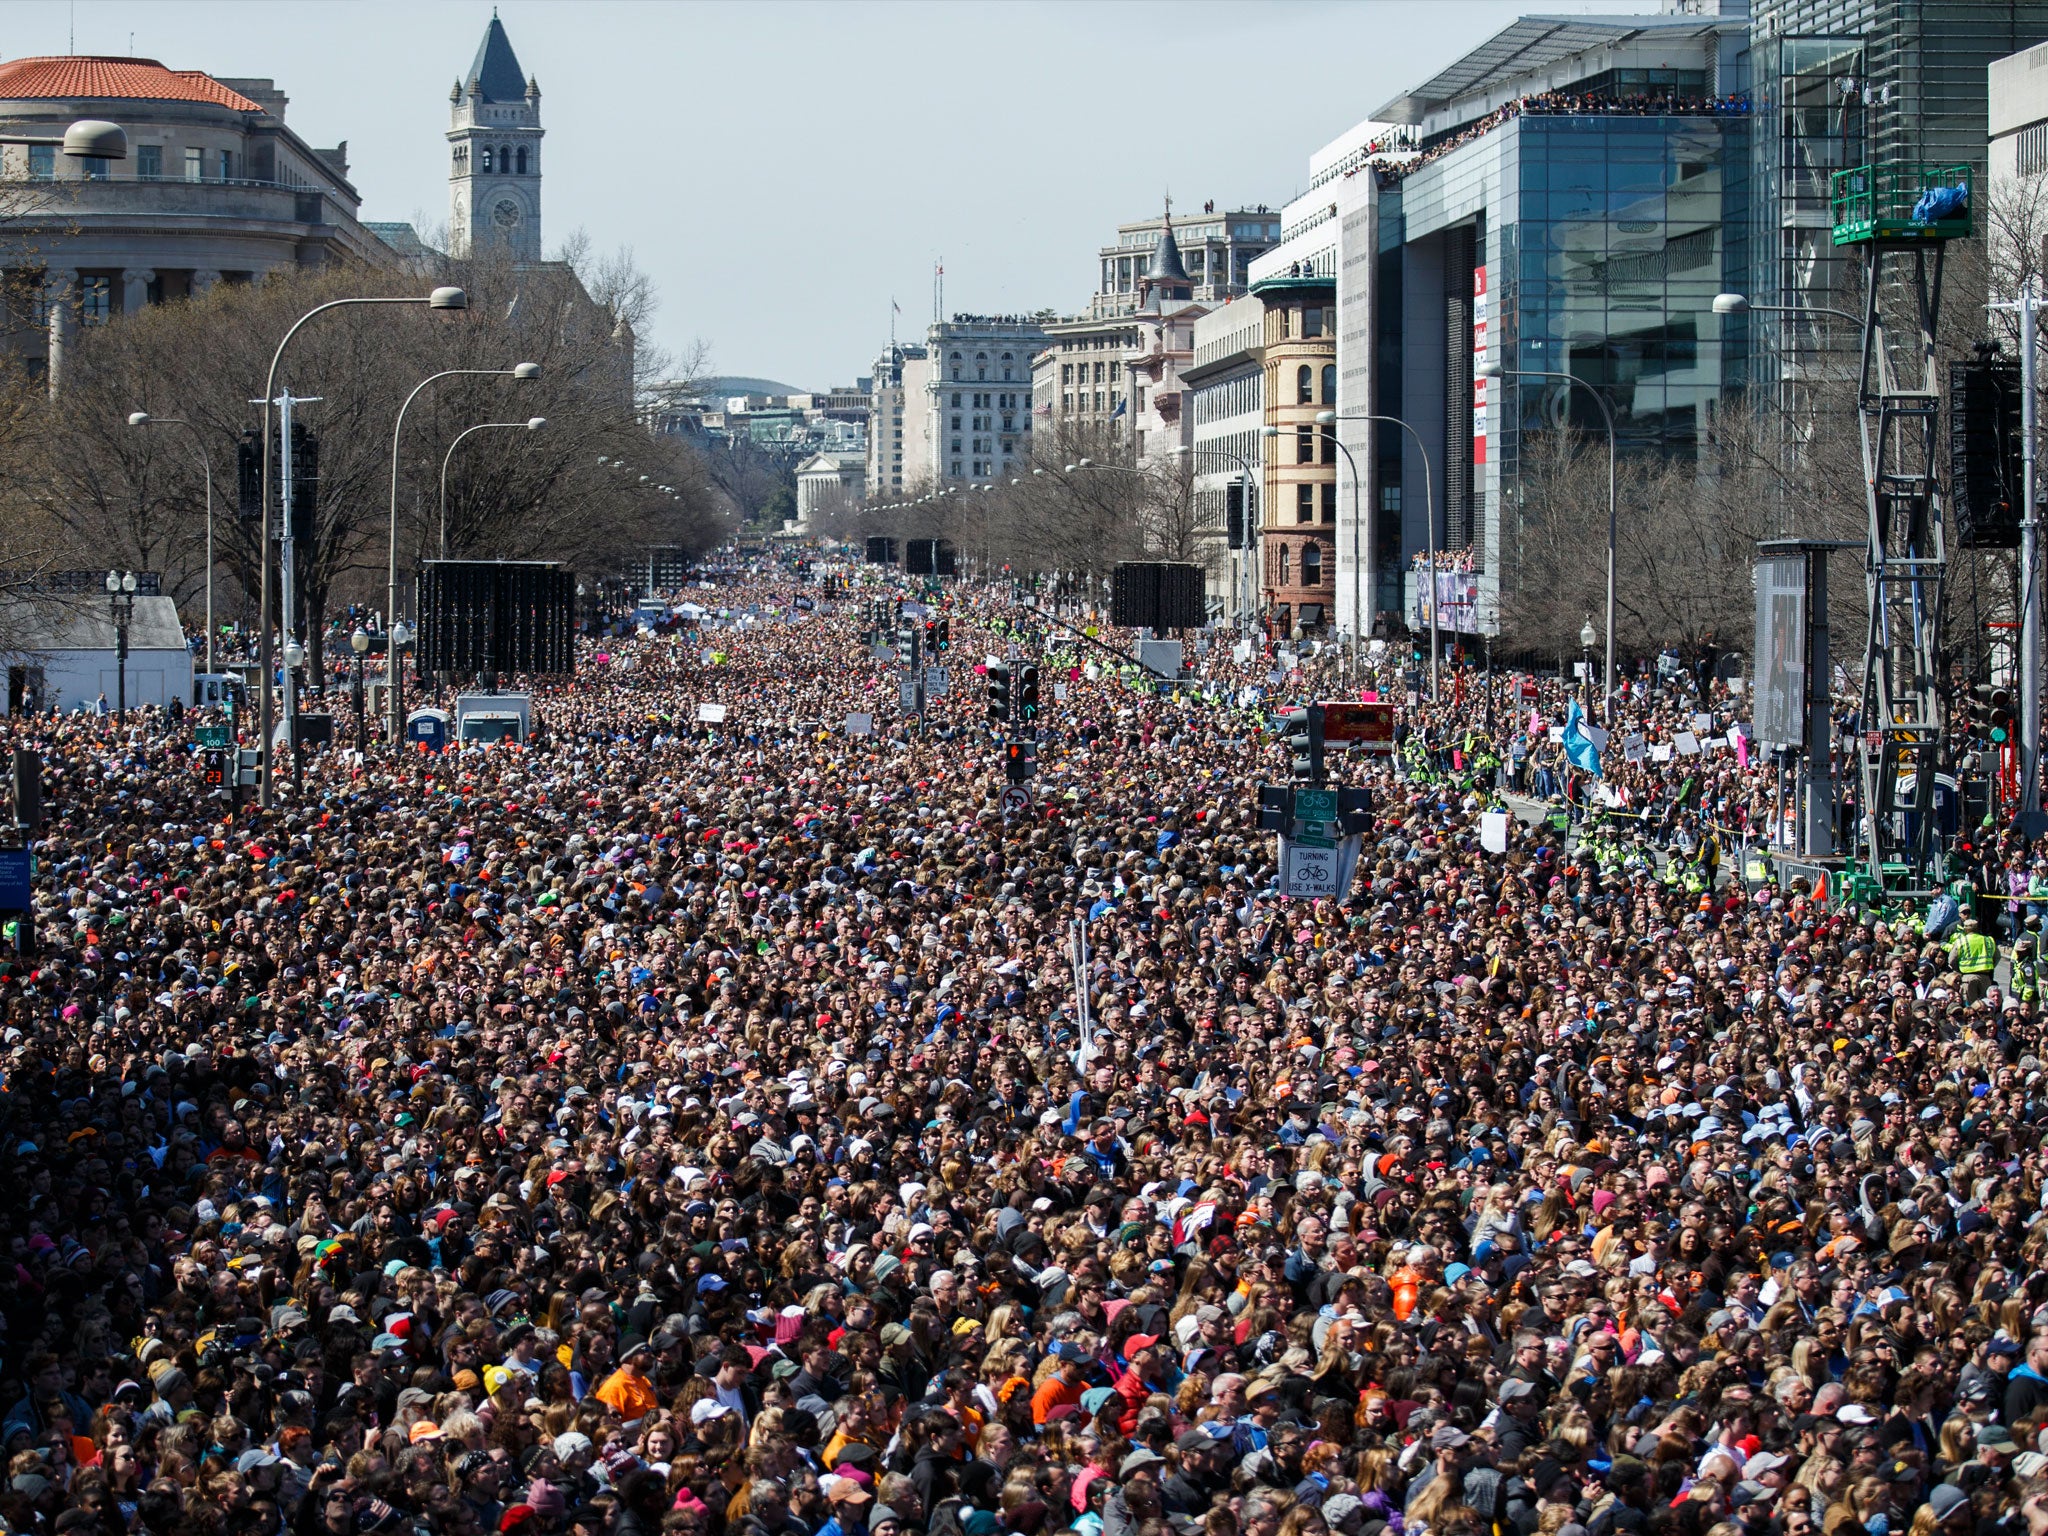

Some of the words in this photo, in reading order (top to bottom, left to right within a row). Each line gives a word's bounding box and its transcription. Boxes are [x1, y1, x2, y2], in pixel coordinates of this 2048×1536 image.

[207, 771, 222, 783] 23
[1299, 852, 1329, 861] TURNING
[1289, 883, 1303, 891] USE
[1305, 884, 1336, 892] X-WALKS
